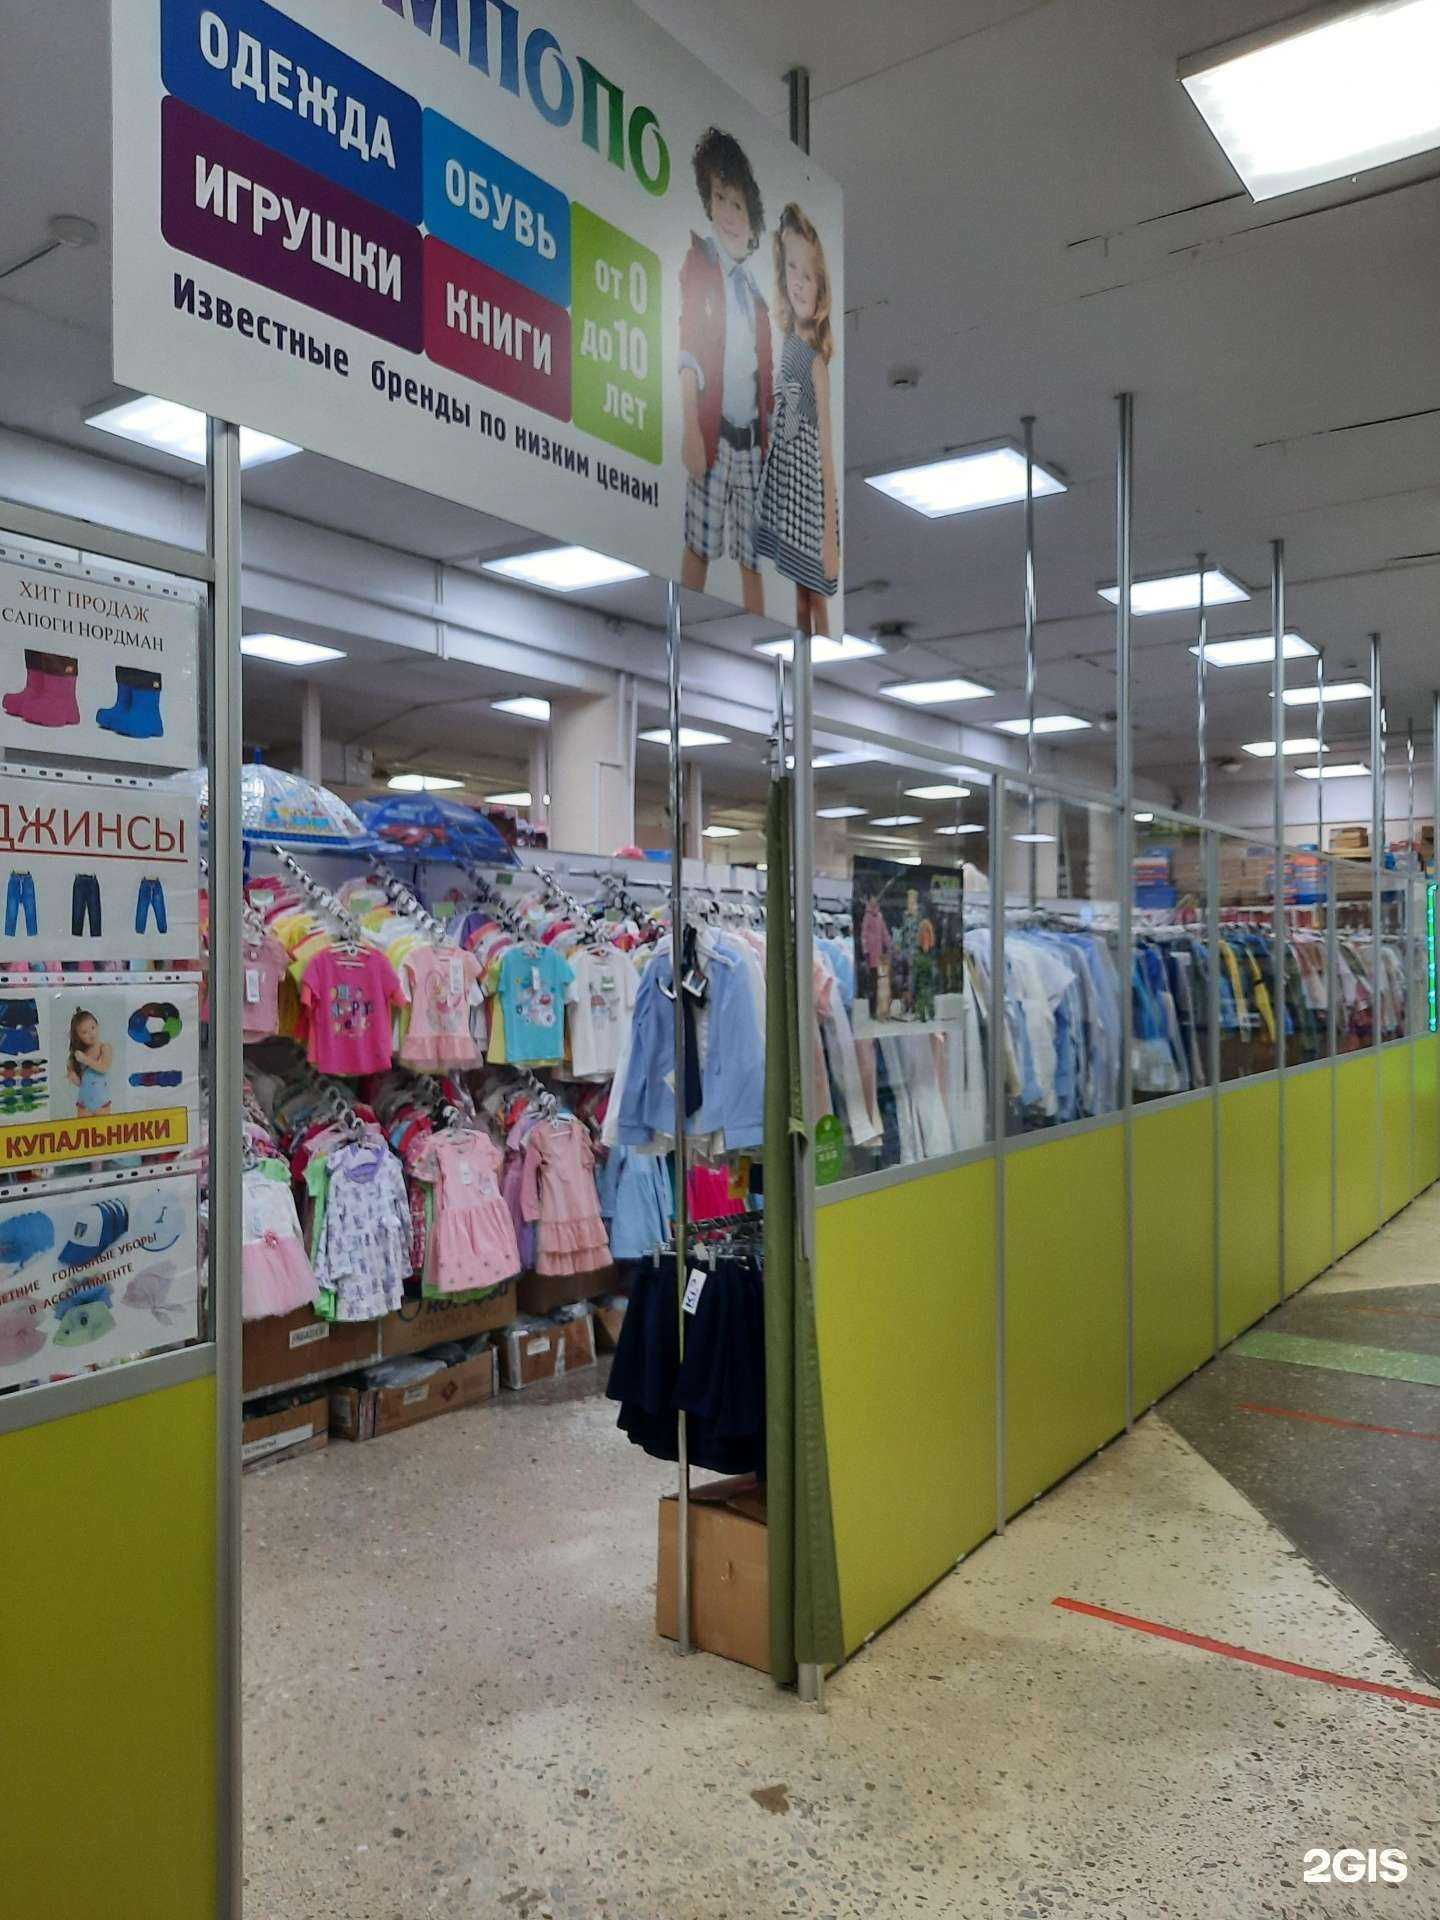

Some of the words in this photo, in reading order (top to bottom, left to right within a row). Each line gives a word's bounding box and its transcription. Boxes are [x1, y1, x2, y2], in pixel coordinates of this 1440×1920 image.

[199, 10, 396, 170] ОДЕЖДА
[195, 154, 402, 303] ИГРУШКИ
[445, 158, 557, 260] ОБУВЬ
[594, 258, 623, 300] от
[629, 261, 648, 315] 0
[445, 281, 552, 376] КНИГИ
[580, 318, 613, 362] до
[614, 318, 648, 381] 10
[173, 272, 349, 377] Известные
[371, 360, 471, 428] бренды
[480, 409, 506, 442] по
[514, 425, 590, 479] низким
[596, 461, 660, 508] ценам!
[602, 382, 647, 431] лет
[2, 607, 74, 635] САПОГИ
[78, 620, 165, 652] НОРДМАН
[19, 580, 62, 605] ХИТ
[67, 591, 150, 624] ПРОДАЖ
[0, 803, 185, 854] ДЖИНСЫ
[6, 1118, 171, 1159] КУПАЛЬНИКИ
[0, 1279, 41, 1306] ЕТНИЕ
[118, 1232, 158, 1256] УБОРЫ
[43, 1261, 134, 1310] АССОРТИМЕНТЕ
